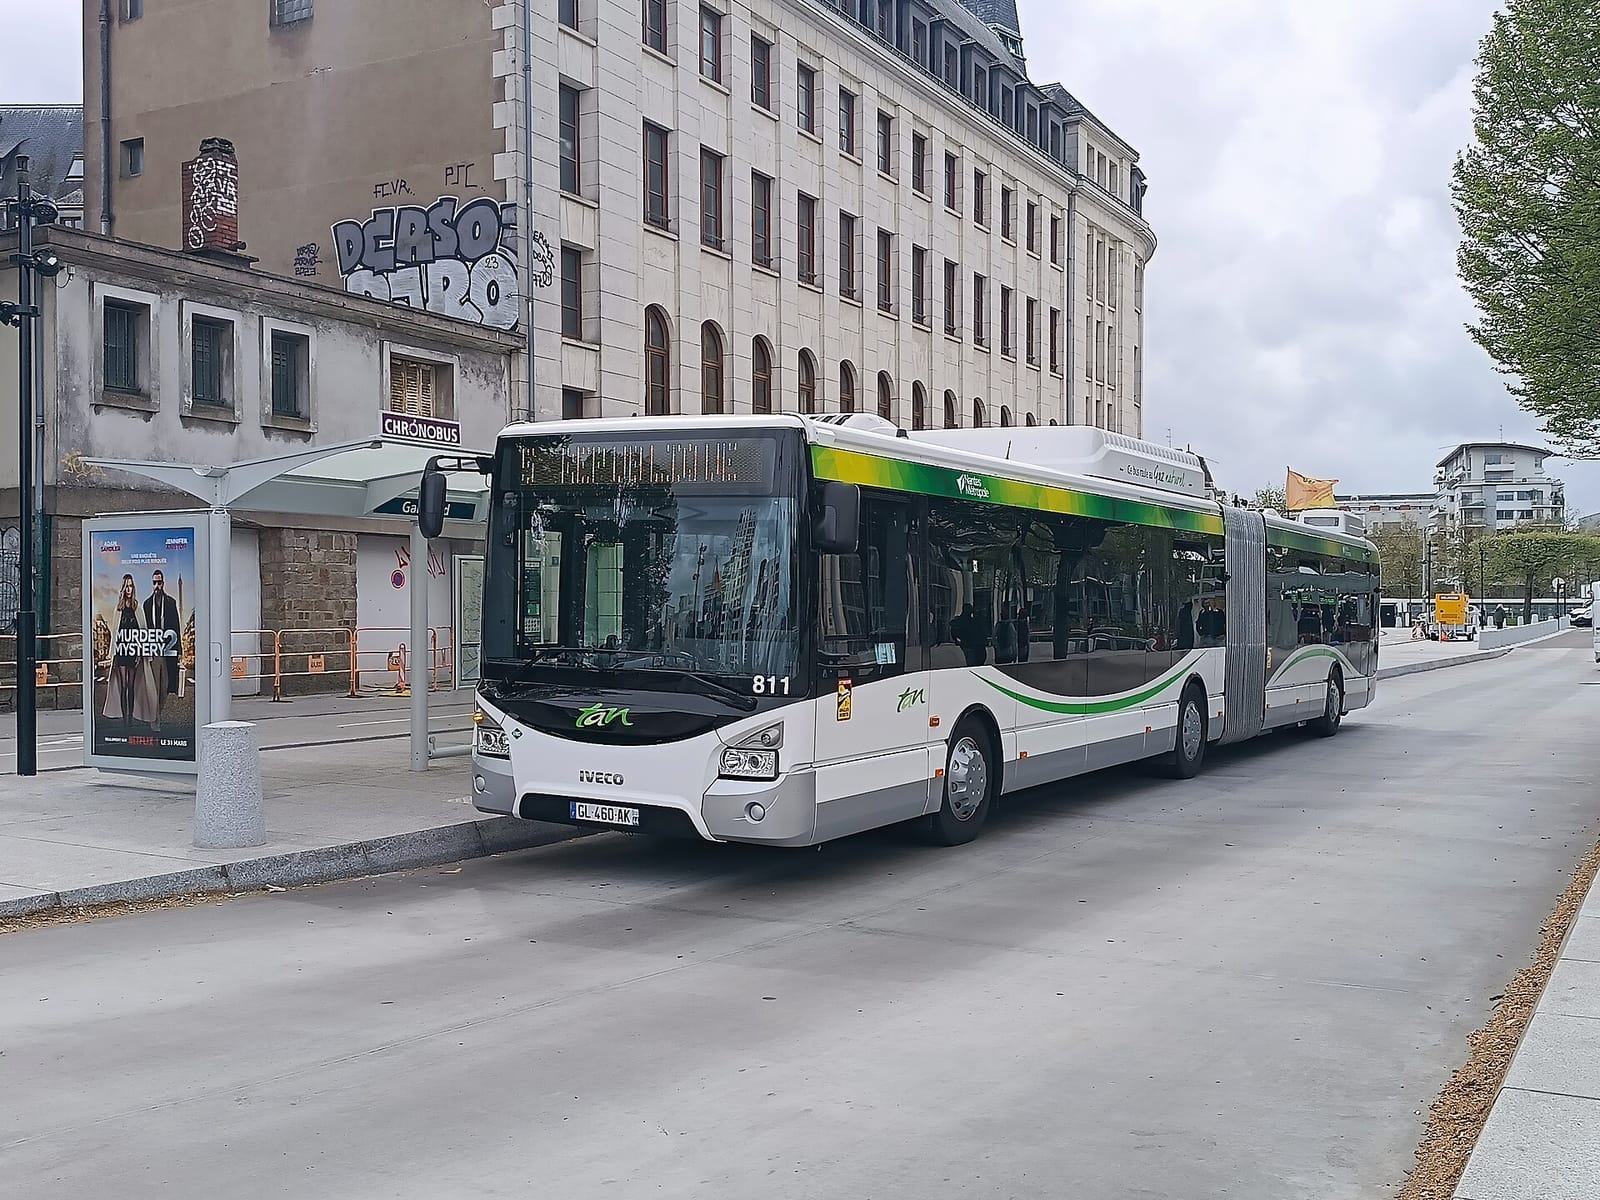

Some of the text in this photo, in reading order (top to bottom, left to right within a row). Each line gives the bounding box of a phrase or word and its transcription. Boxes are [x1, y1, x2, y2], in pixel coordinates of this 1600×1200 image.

[484, 257, 499, 269] 23
[116, 628, 164, 643] MURDER
[162, 629, 178, 657] 2
[114, 642, 166, 657] MYSTERY
[752, 675, 792, 695] 811
[897, 687, 926, 713] tan
[575, 703, 634, 728] tan
[579, 770, 624, 786] IVECO
